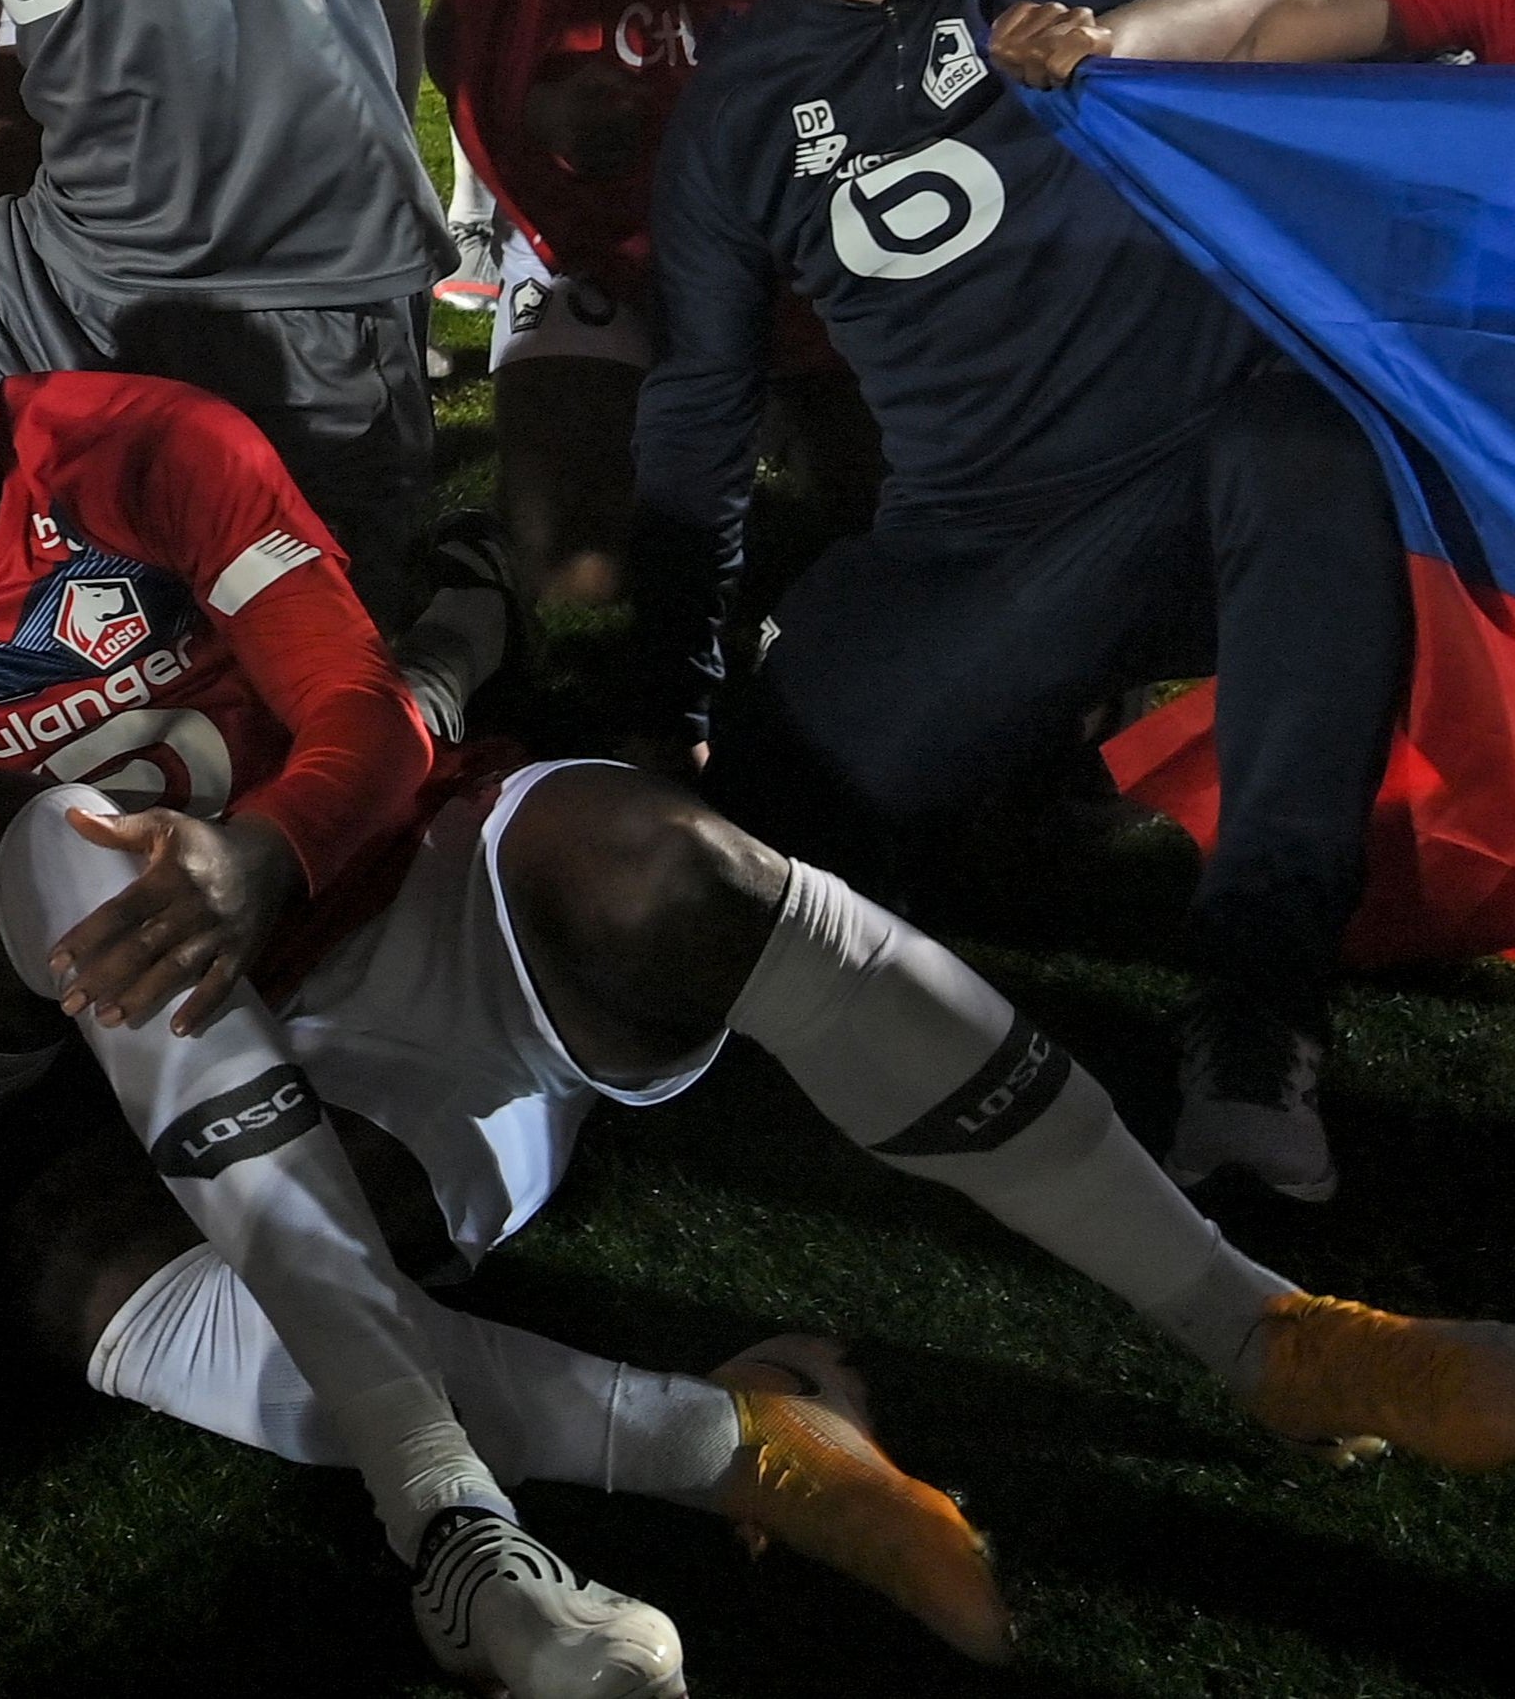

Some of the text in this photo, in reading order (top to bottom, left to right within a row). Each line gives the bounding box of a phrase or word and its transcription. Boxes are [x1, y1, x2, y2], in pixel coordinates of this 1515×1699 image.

[938, 62, 974, 96] LOSC
[796, 106, 829, 134] DP
[94, 620, 143, 663] LOSC
[956, 1030, 1051, 1134] LOSC
[181, 1081, 305, 1159] LOSC
